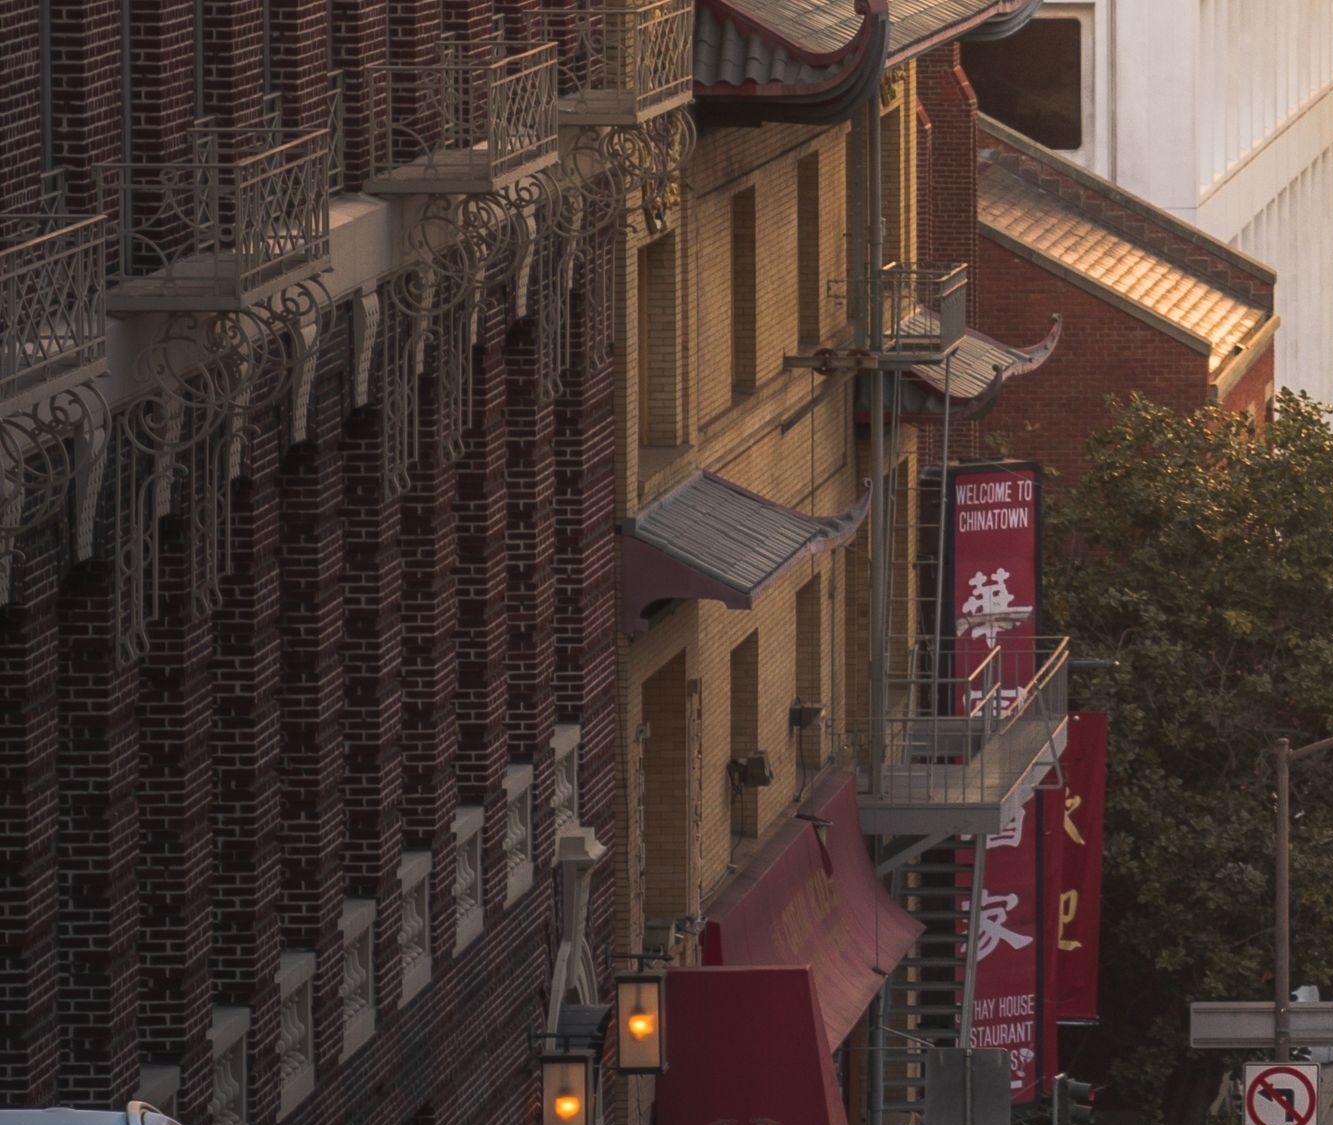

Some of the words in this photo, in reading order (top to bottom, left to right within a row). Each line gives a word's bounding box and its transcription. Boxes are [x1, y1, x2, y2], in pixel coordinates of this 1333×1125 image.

[956, 481, 1012, 506] WELCOME
[1017, 479, 1033, 501] TO
[959, 507, 1028, 532] CHINATOWN
[999, 994, 1035, 1018] HOUSE
[956, 1020, 1035, 1047] STAURANT
